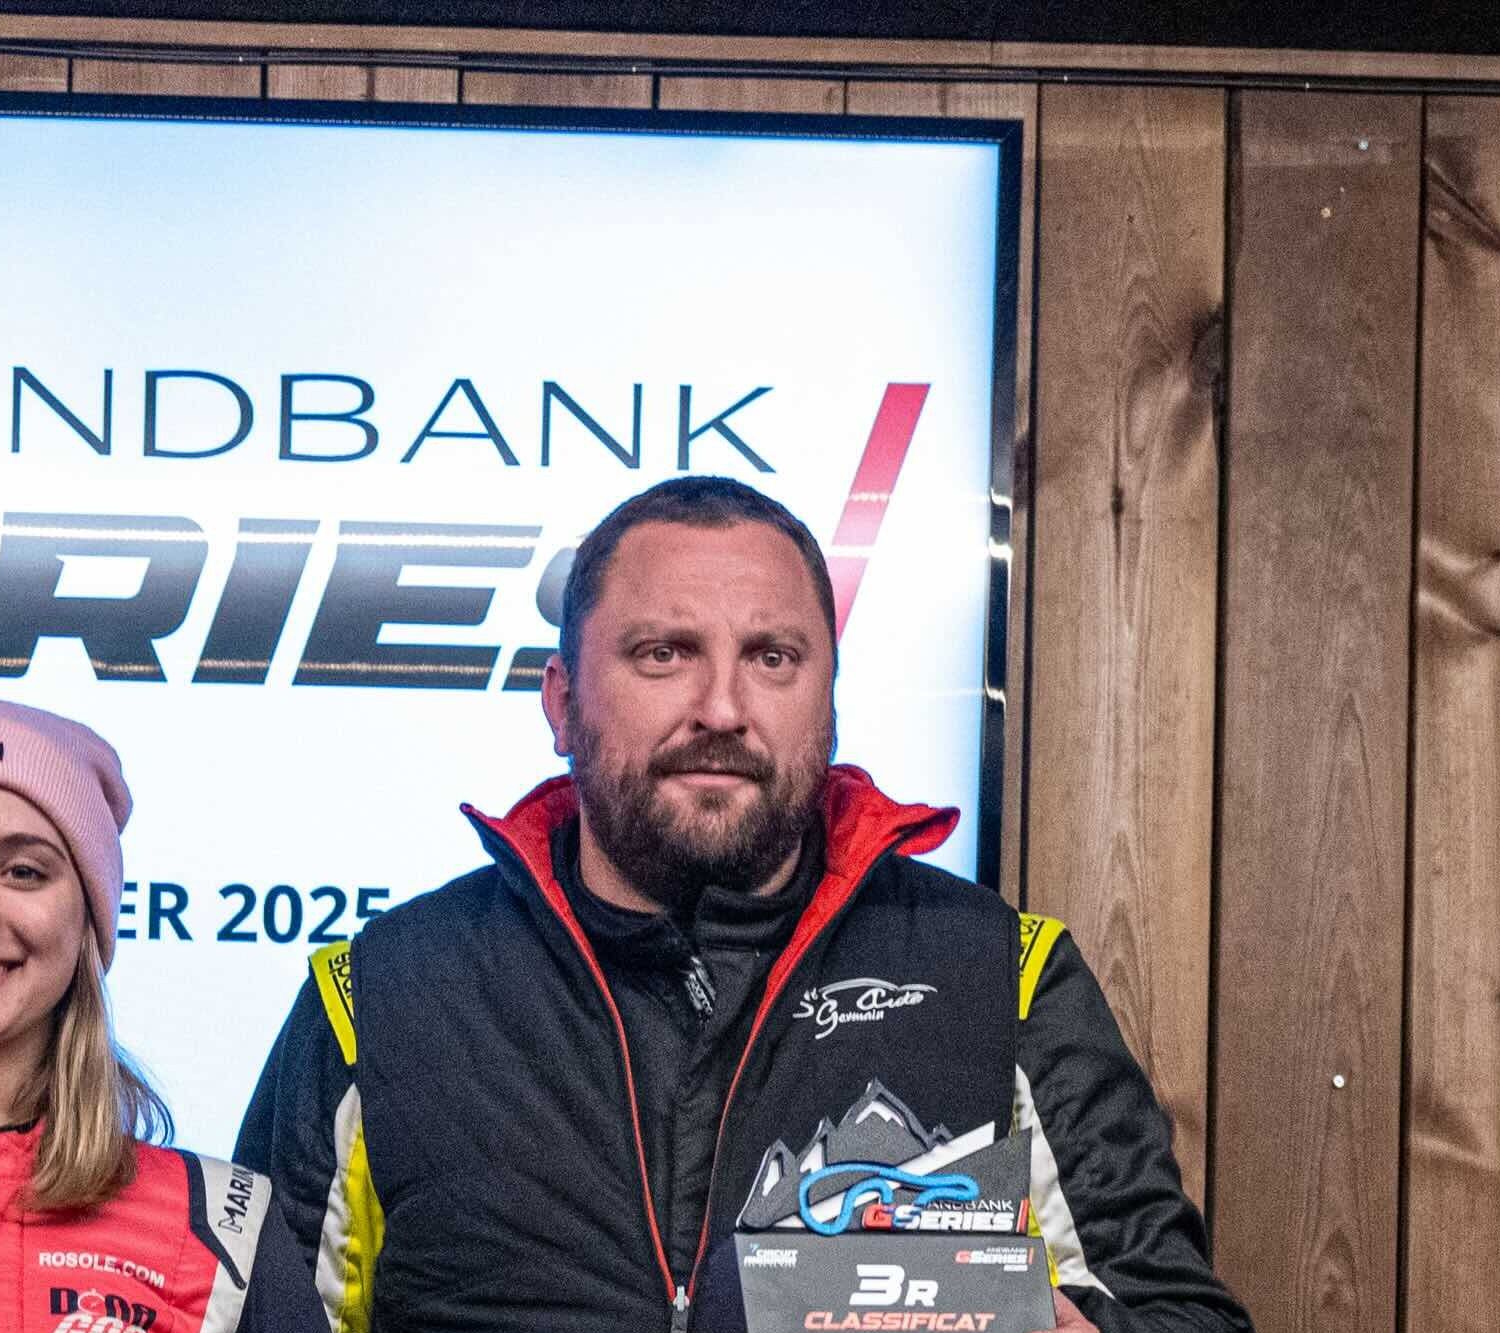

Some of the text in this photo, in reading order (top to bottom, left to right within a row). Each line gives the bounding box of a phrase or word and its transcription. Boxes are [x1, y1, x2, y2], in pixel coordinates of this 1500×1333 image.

[216, 884, 391, 944] 2025
[862, 1203, 1014, 1232] GSERIES
[39, 1251, 165, 1288] ROSOLE.COM
[849, 1263, 940, 1308] 3R
[803, 1310, 996, 1333] CLASSIFICAT
